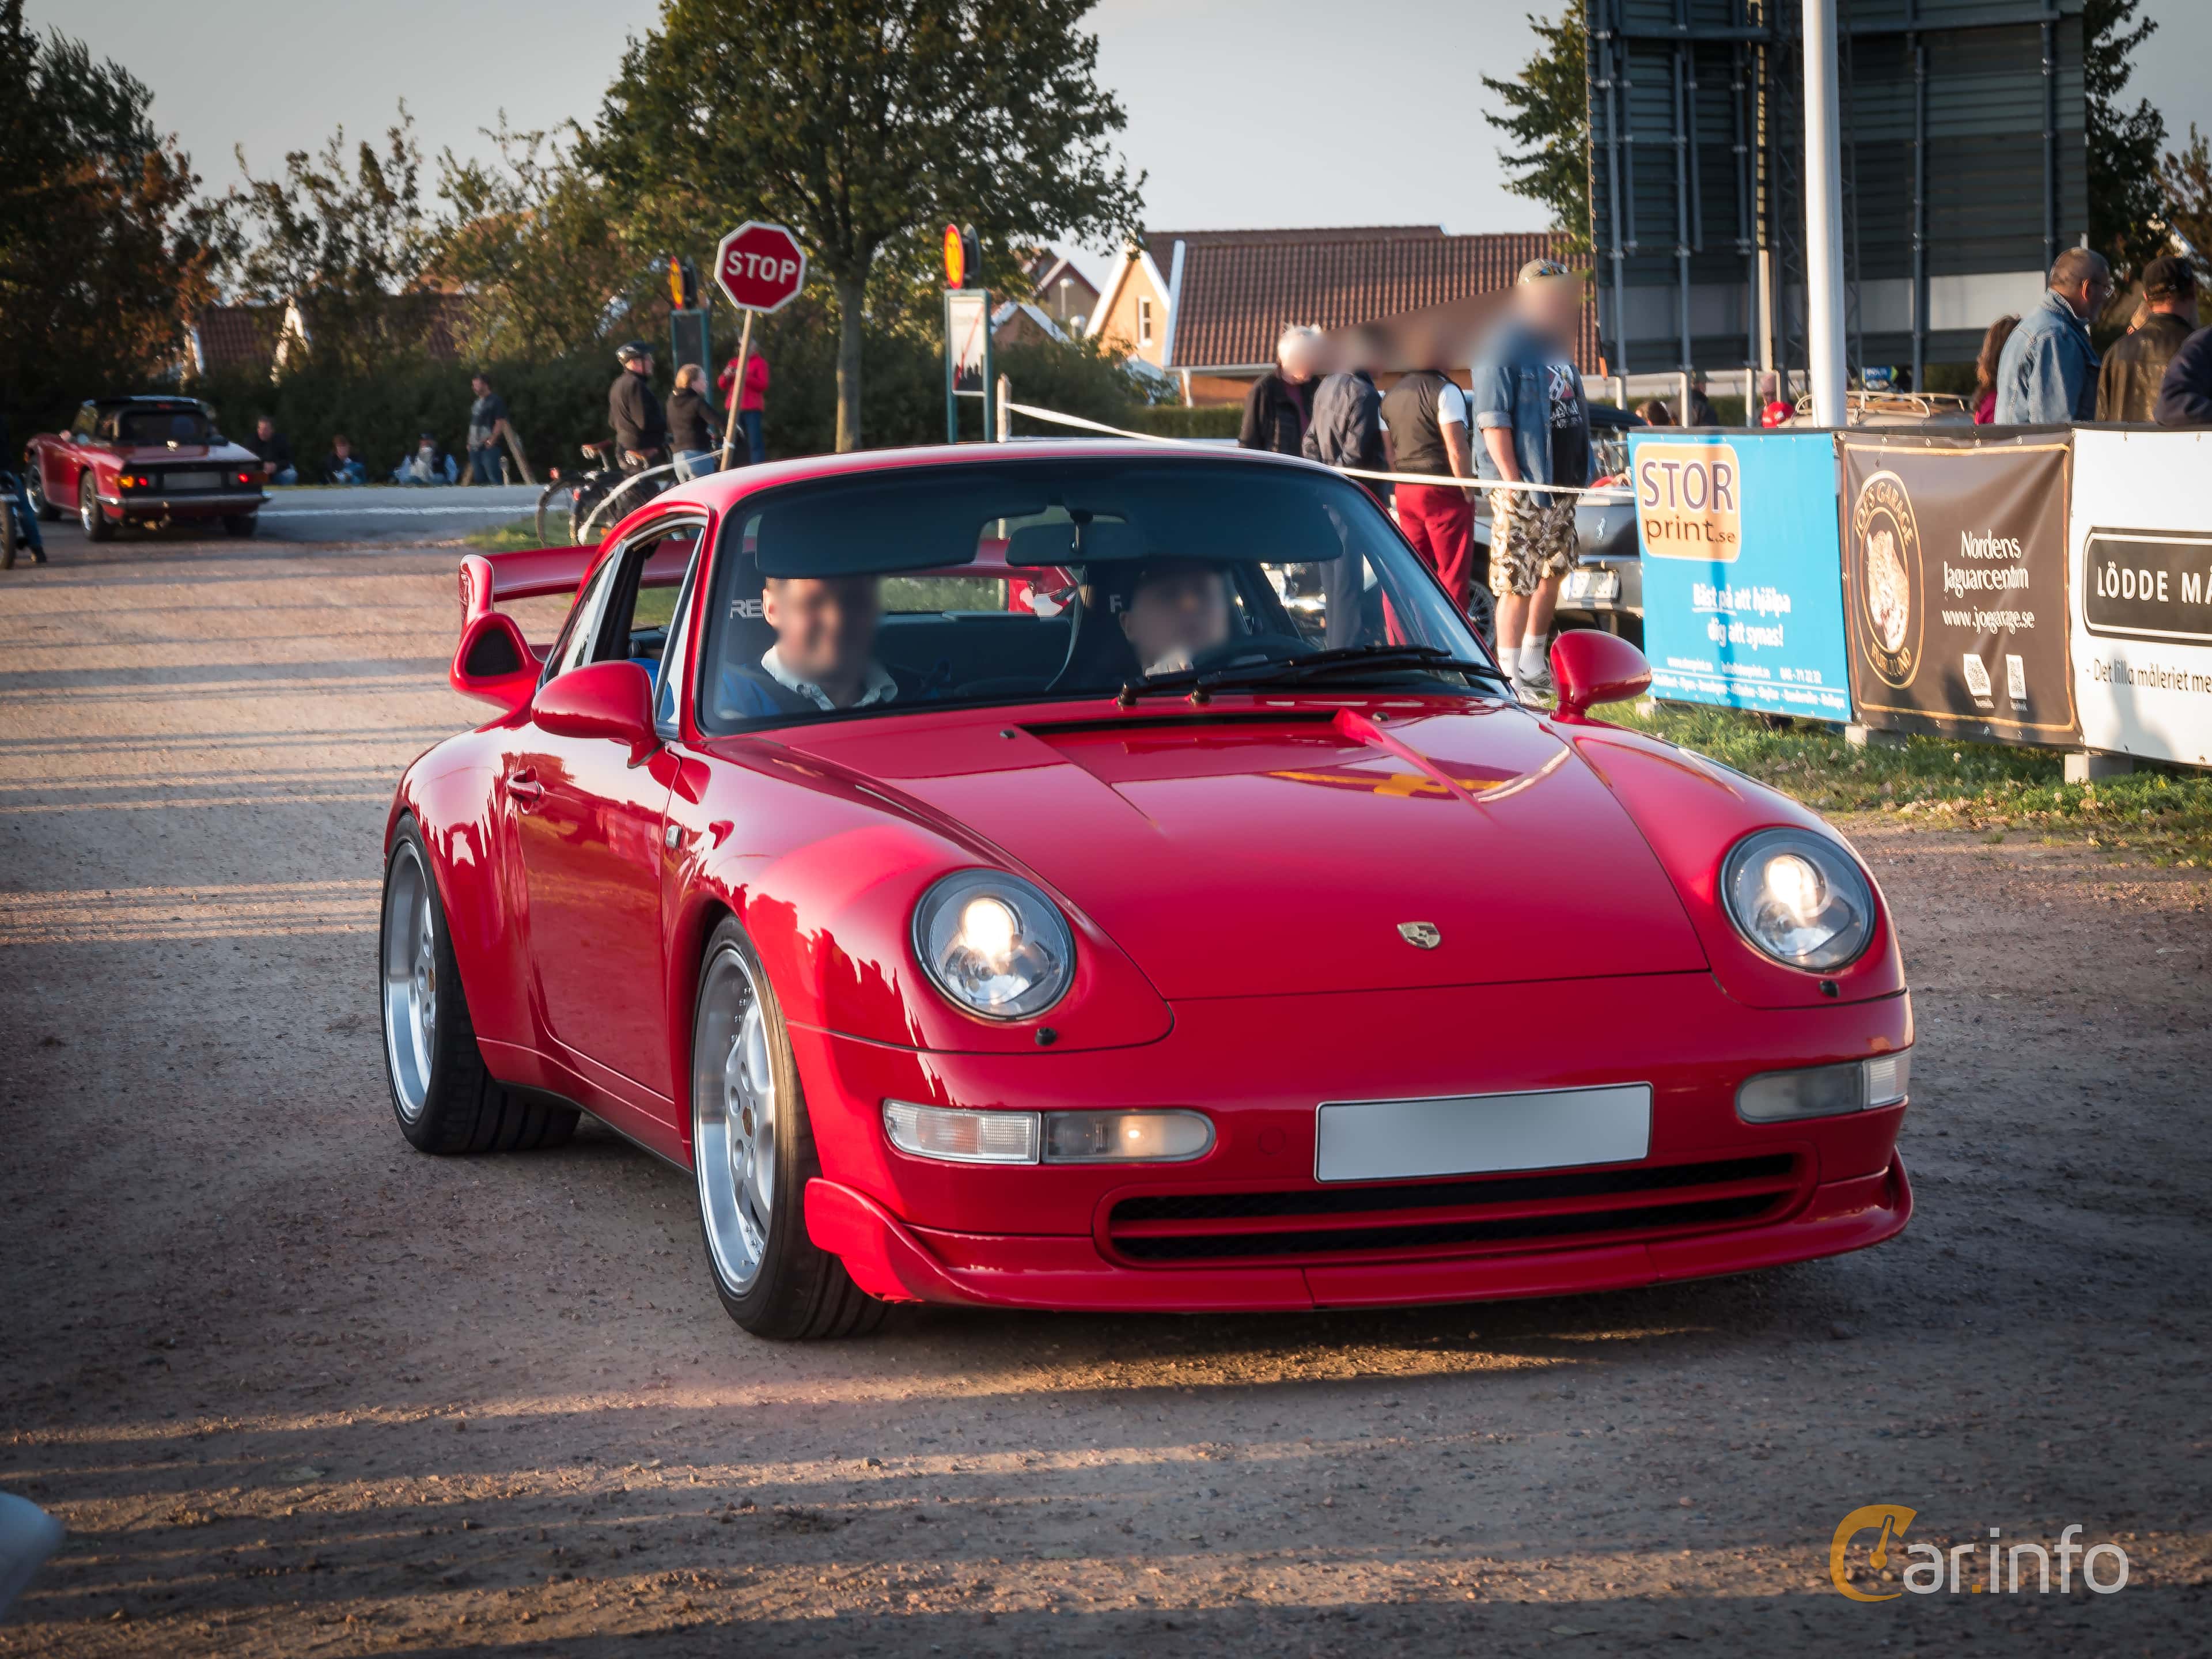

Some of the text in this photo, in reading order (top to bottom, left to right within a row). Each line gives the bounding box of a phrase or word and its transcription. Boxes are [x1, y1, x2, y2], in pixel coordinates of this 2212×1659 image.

[726, 250, 797, 284] STOP
[1642, 461, 1733, 510] STOR
[1645, 514, 1735, 544] print.se
[1877, 482, 1914, 547] GARAGE
[1961, 528, 2022, 559] Nordens
[2097, 561, 2169, 602] LÖDDE
[729, 599, 763, 619] RE
[1693, 583, 1791, 618] Bäst på att hjälpa
[1707, 617, 1783, 651] dig att synas!
[2094, 658, 2112, 683] Det
[2114, 658, 2134, 685] lilla
[2138, 662, 2188, 691] måleriet
